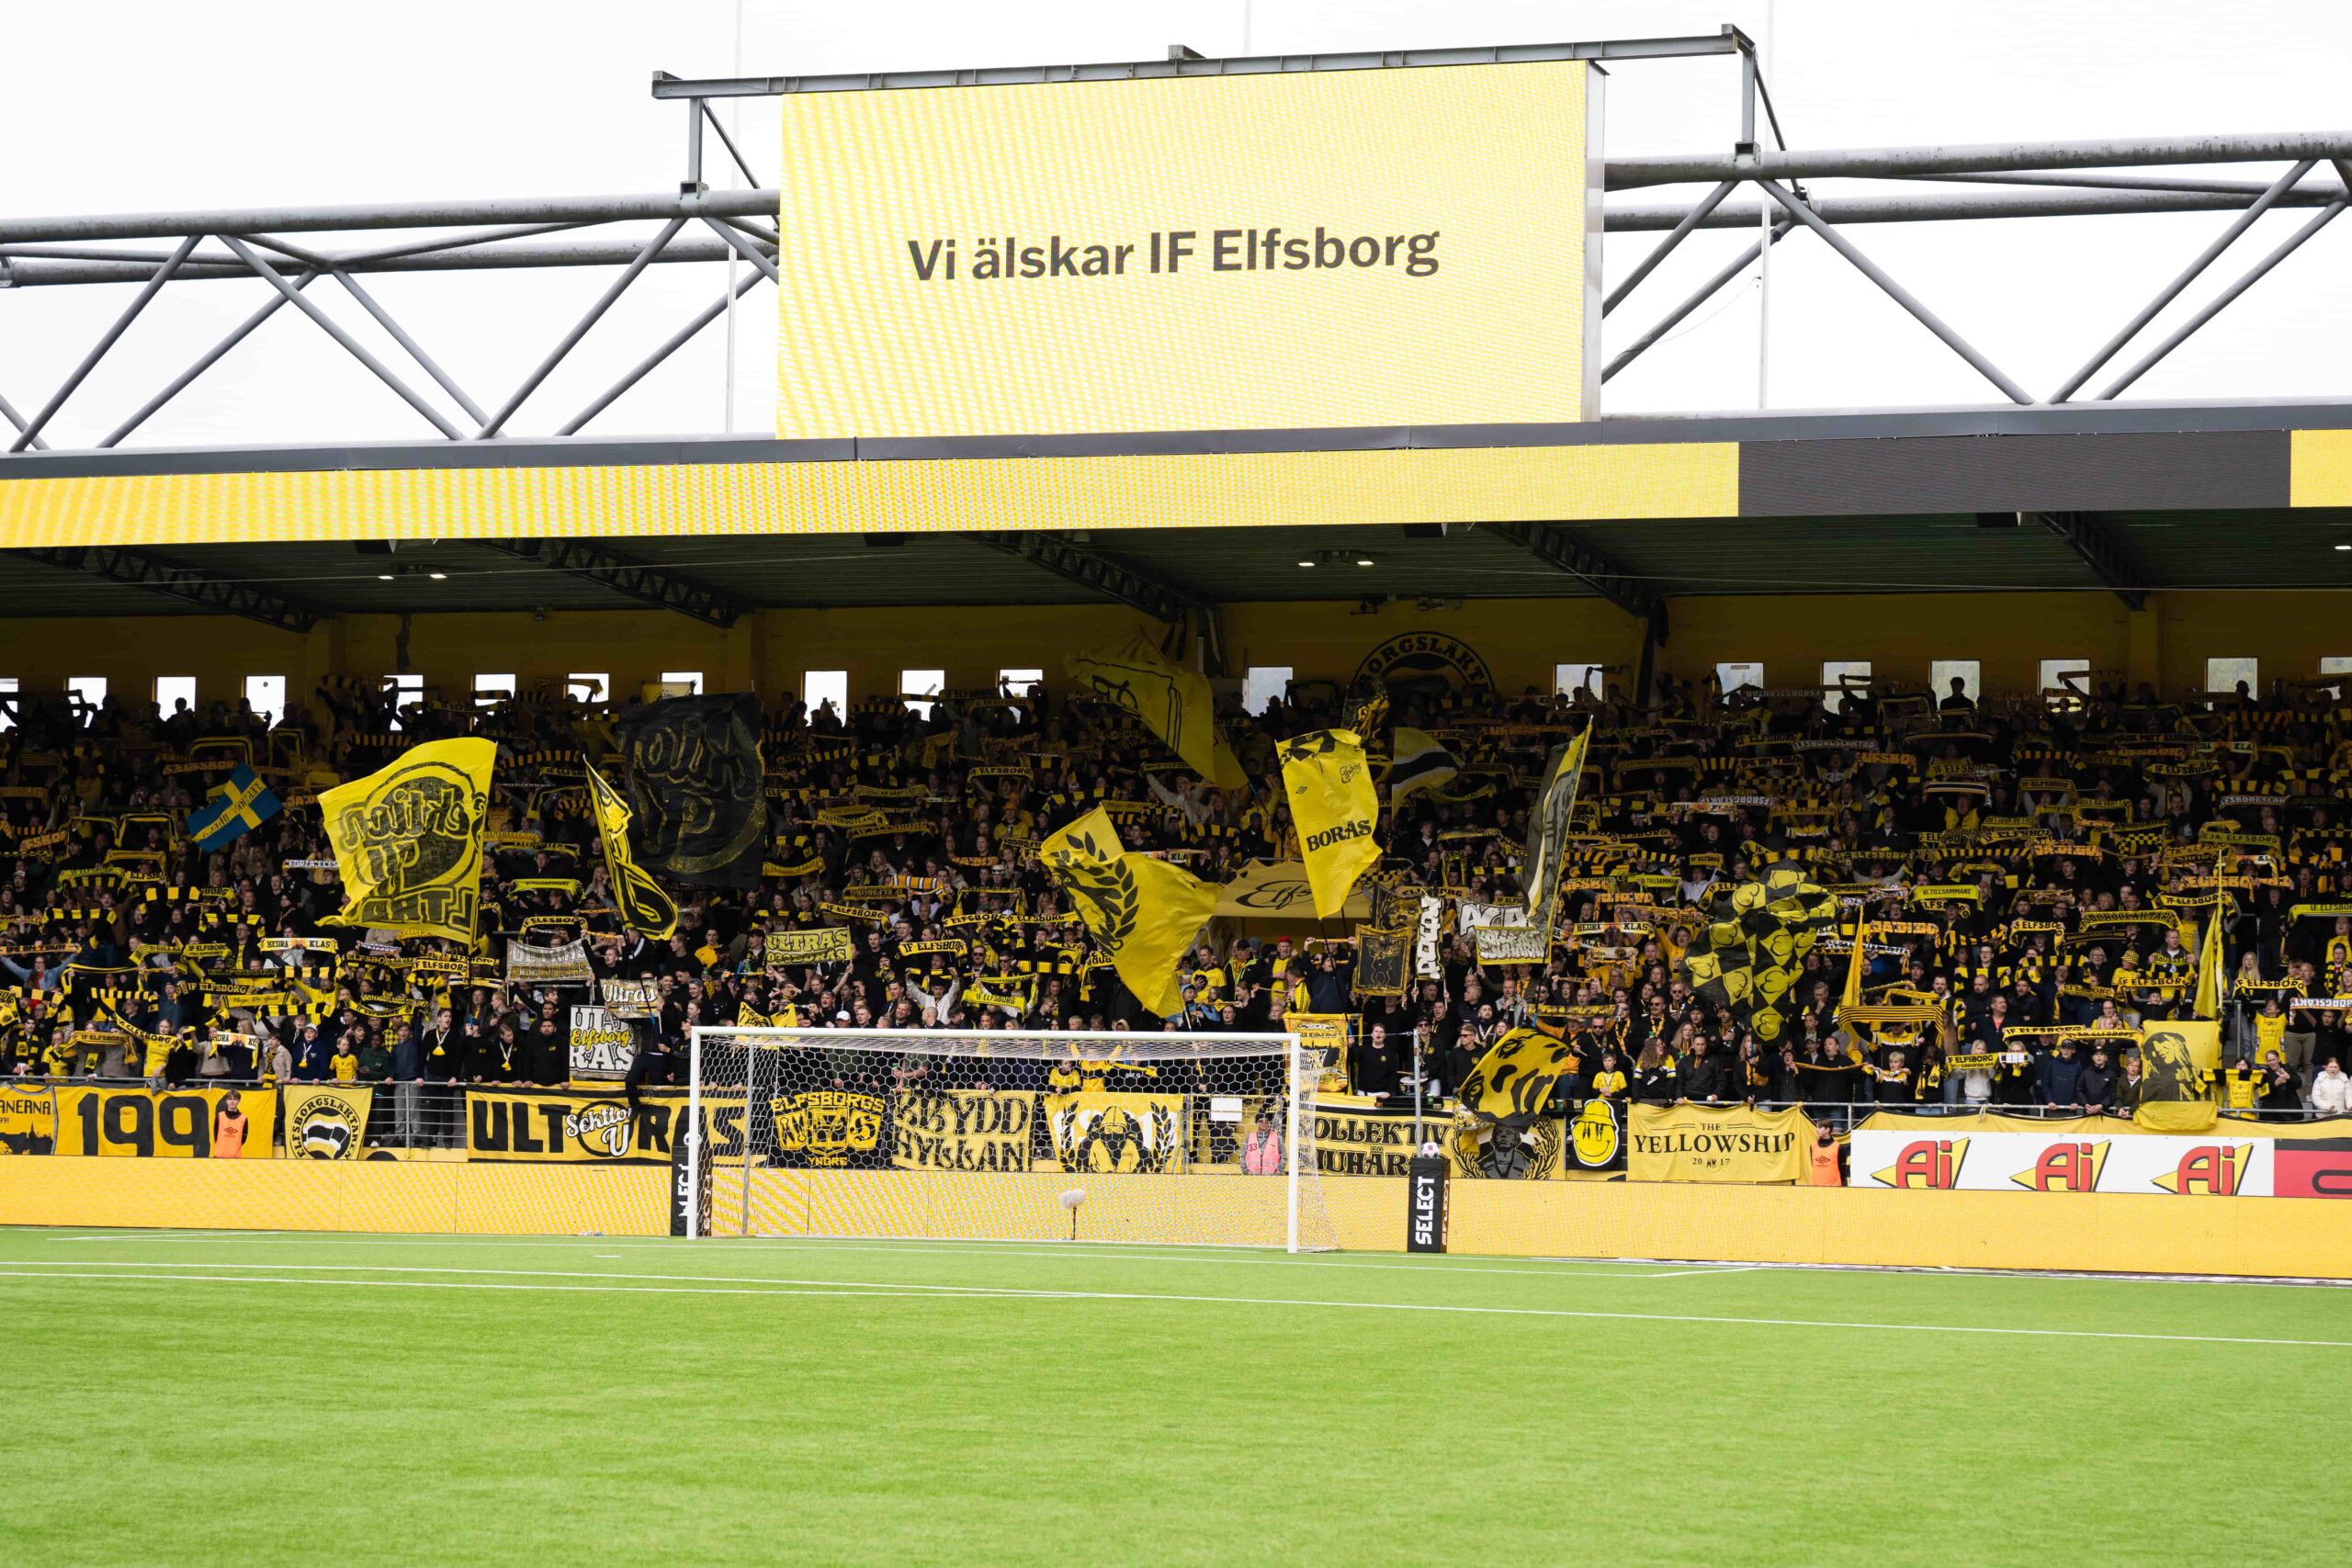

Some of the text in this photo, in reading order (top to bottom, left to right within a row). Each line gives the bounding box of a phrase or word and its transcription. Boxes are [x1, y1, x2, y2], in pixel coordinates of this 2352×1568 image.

[908, 227, 1441, 281] Vi älskar IF Elfsborg
[1358, 637, 1487, 684] ORGSLÄKT
[1306, 819, 1372, 852] BORÅS
[288, 859, 339, 867] FORZA ELFS
[1719, 882, 1741, 891] ELFS
[1931, 887, 1972, 897] TILLSAMMANS
[838, 906, 885, 919] ELFSBORG
[1624, 922, 1648, 932] KLAS
[310, 939, 332, 950] KLAS
[766, 930, 847, 952] ULTRAS
[904, 943, 913, 952] IF
[424, 962, 469, 974] ELFSBORG
[188, 983, 248, 993] IF ELFSBORG
[2248, 978, 2304, 990] ELFSBORG
[603, 983, 658, 1003] Ultras
[984, 995, 1015, 1005] ELFSBORG
[127, 1024, 172, 1044] ELFSBORG
[2006, 1025, 2081, 1037] IF ELFSBORG
[571, 1028, 632, 1052] Elfsborg
[1958, 1054, 1994, 1065] ELFSBORG
[772, 1090, 887, 1113] ELFSBORGS
[77, 1092, 250, 1156] 199
[1700, 1123, 1721, 1134] THE
[1248, 1143, 1259, 1154] 33
[1634, 1132, 1794, 1156] YELLOWSHIP
[1691, 1156, 1731, 1166] 20 17
[1415, 1177, 1435, 1246] SELECT
